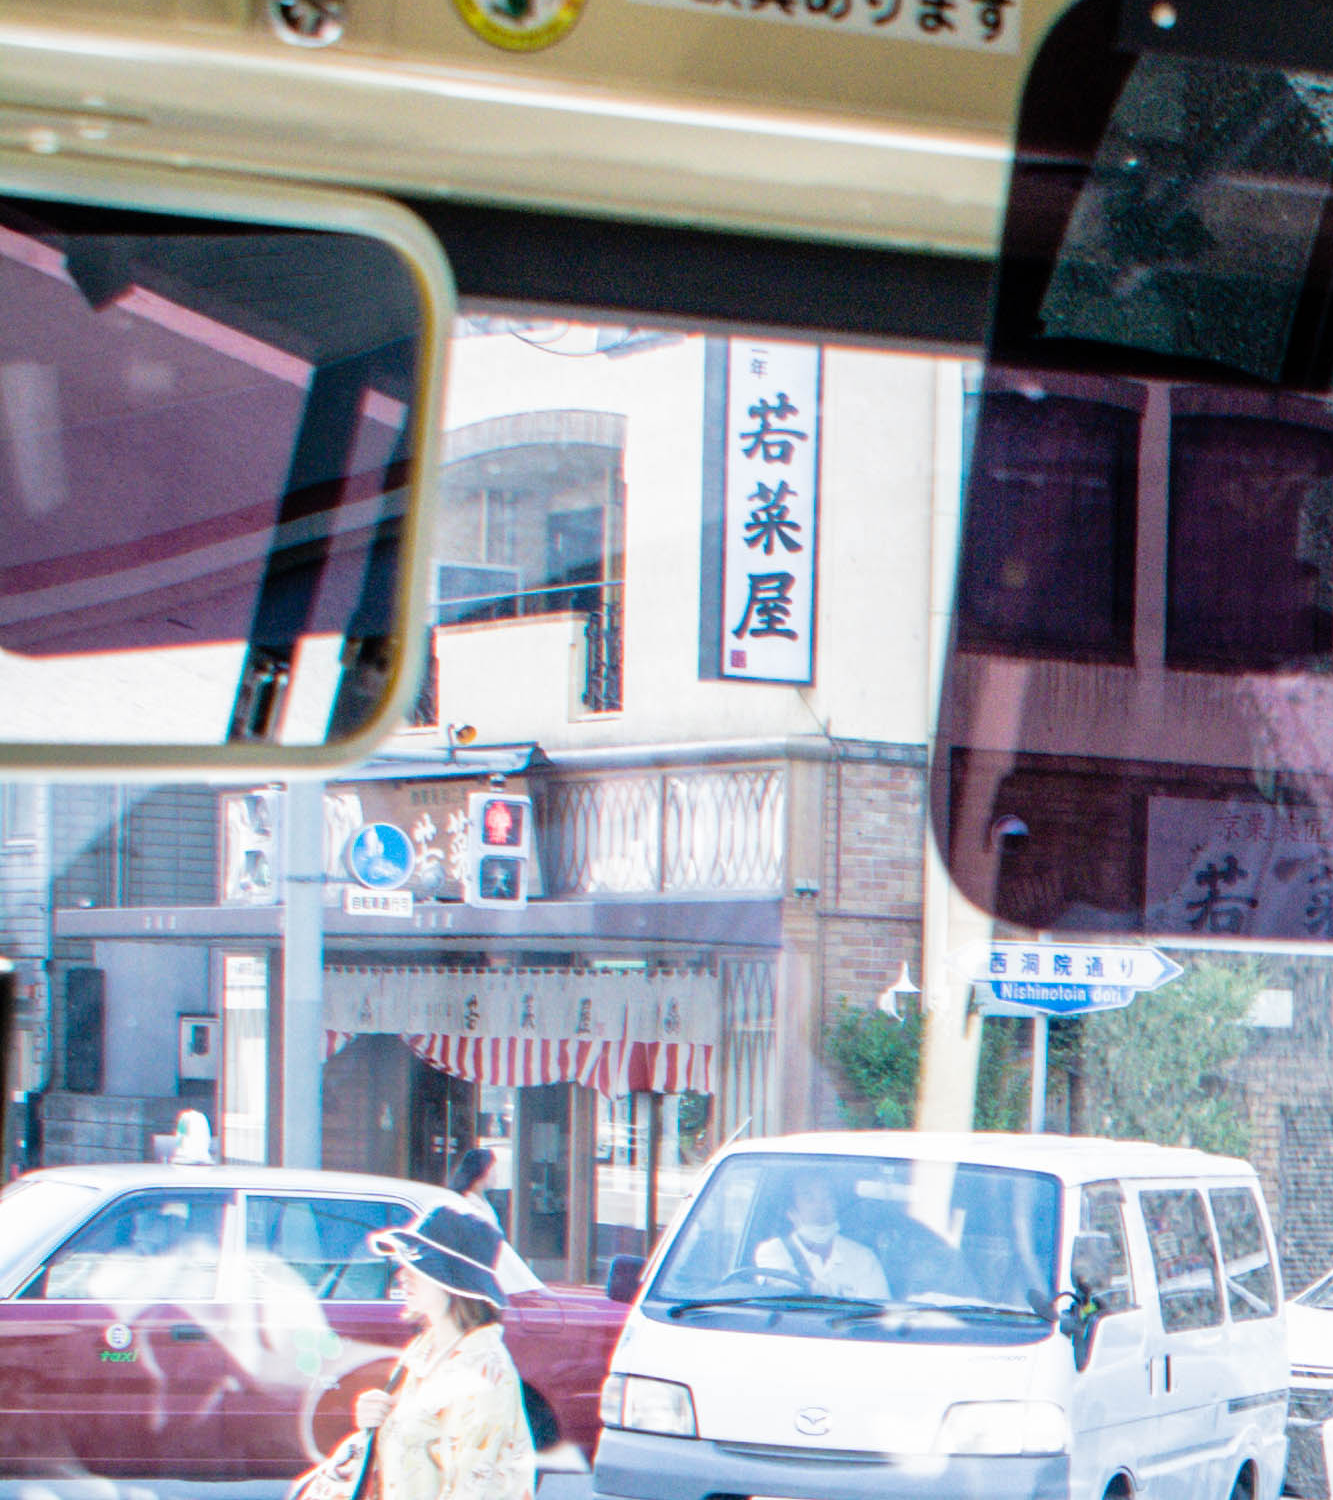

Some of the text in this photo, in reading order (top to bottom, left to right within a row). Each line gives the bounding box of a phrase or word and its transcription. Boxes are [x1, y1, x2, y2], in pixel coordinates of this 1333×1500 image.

[732, 391, 808, 642] 若菜屋
[989, 952, 1134, 979] 西洞院通り
